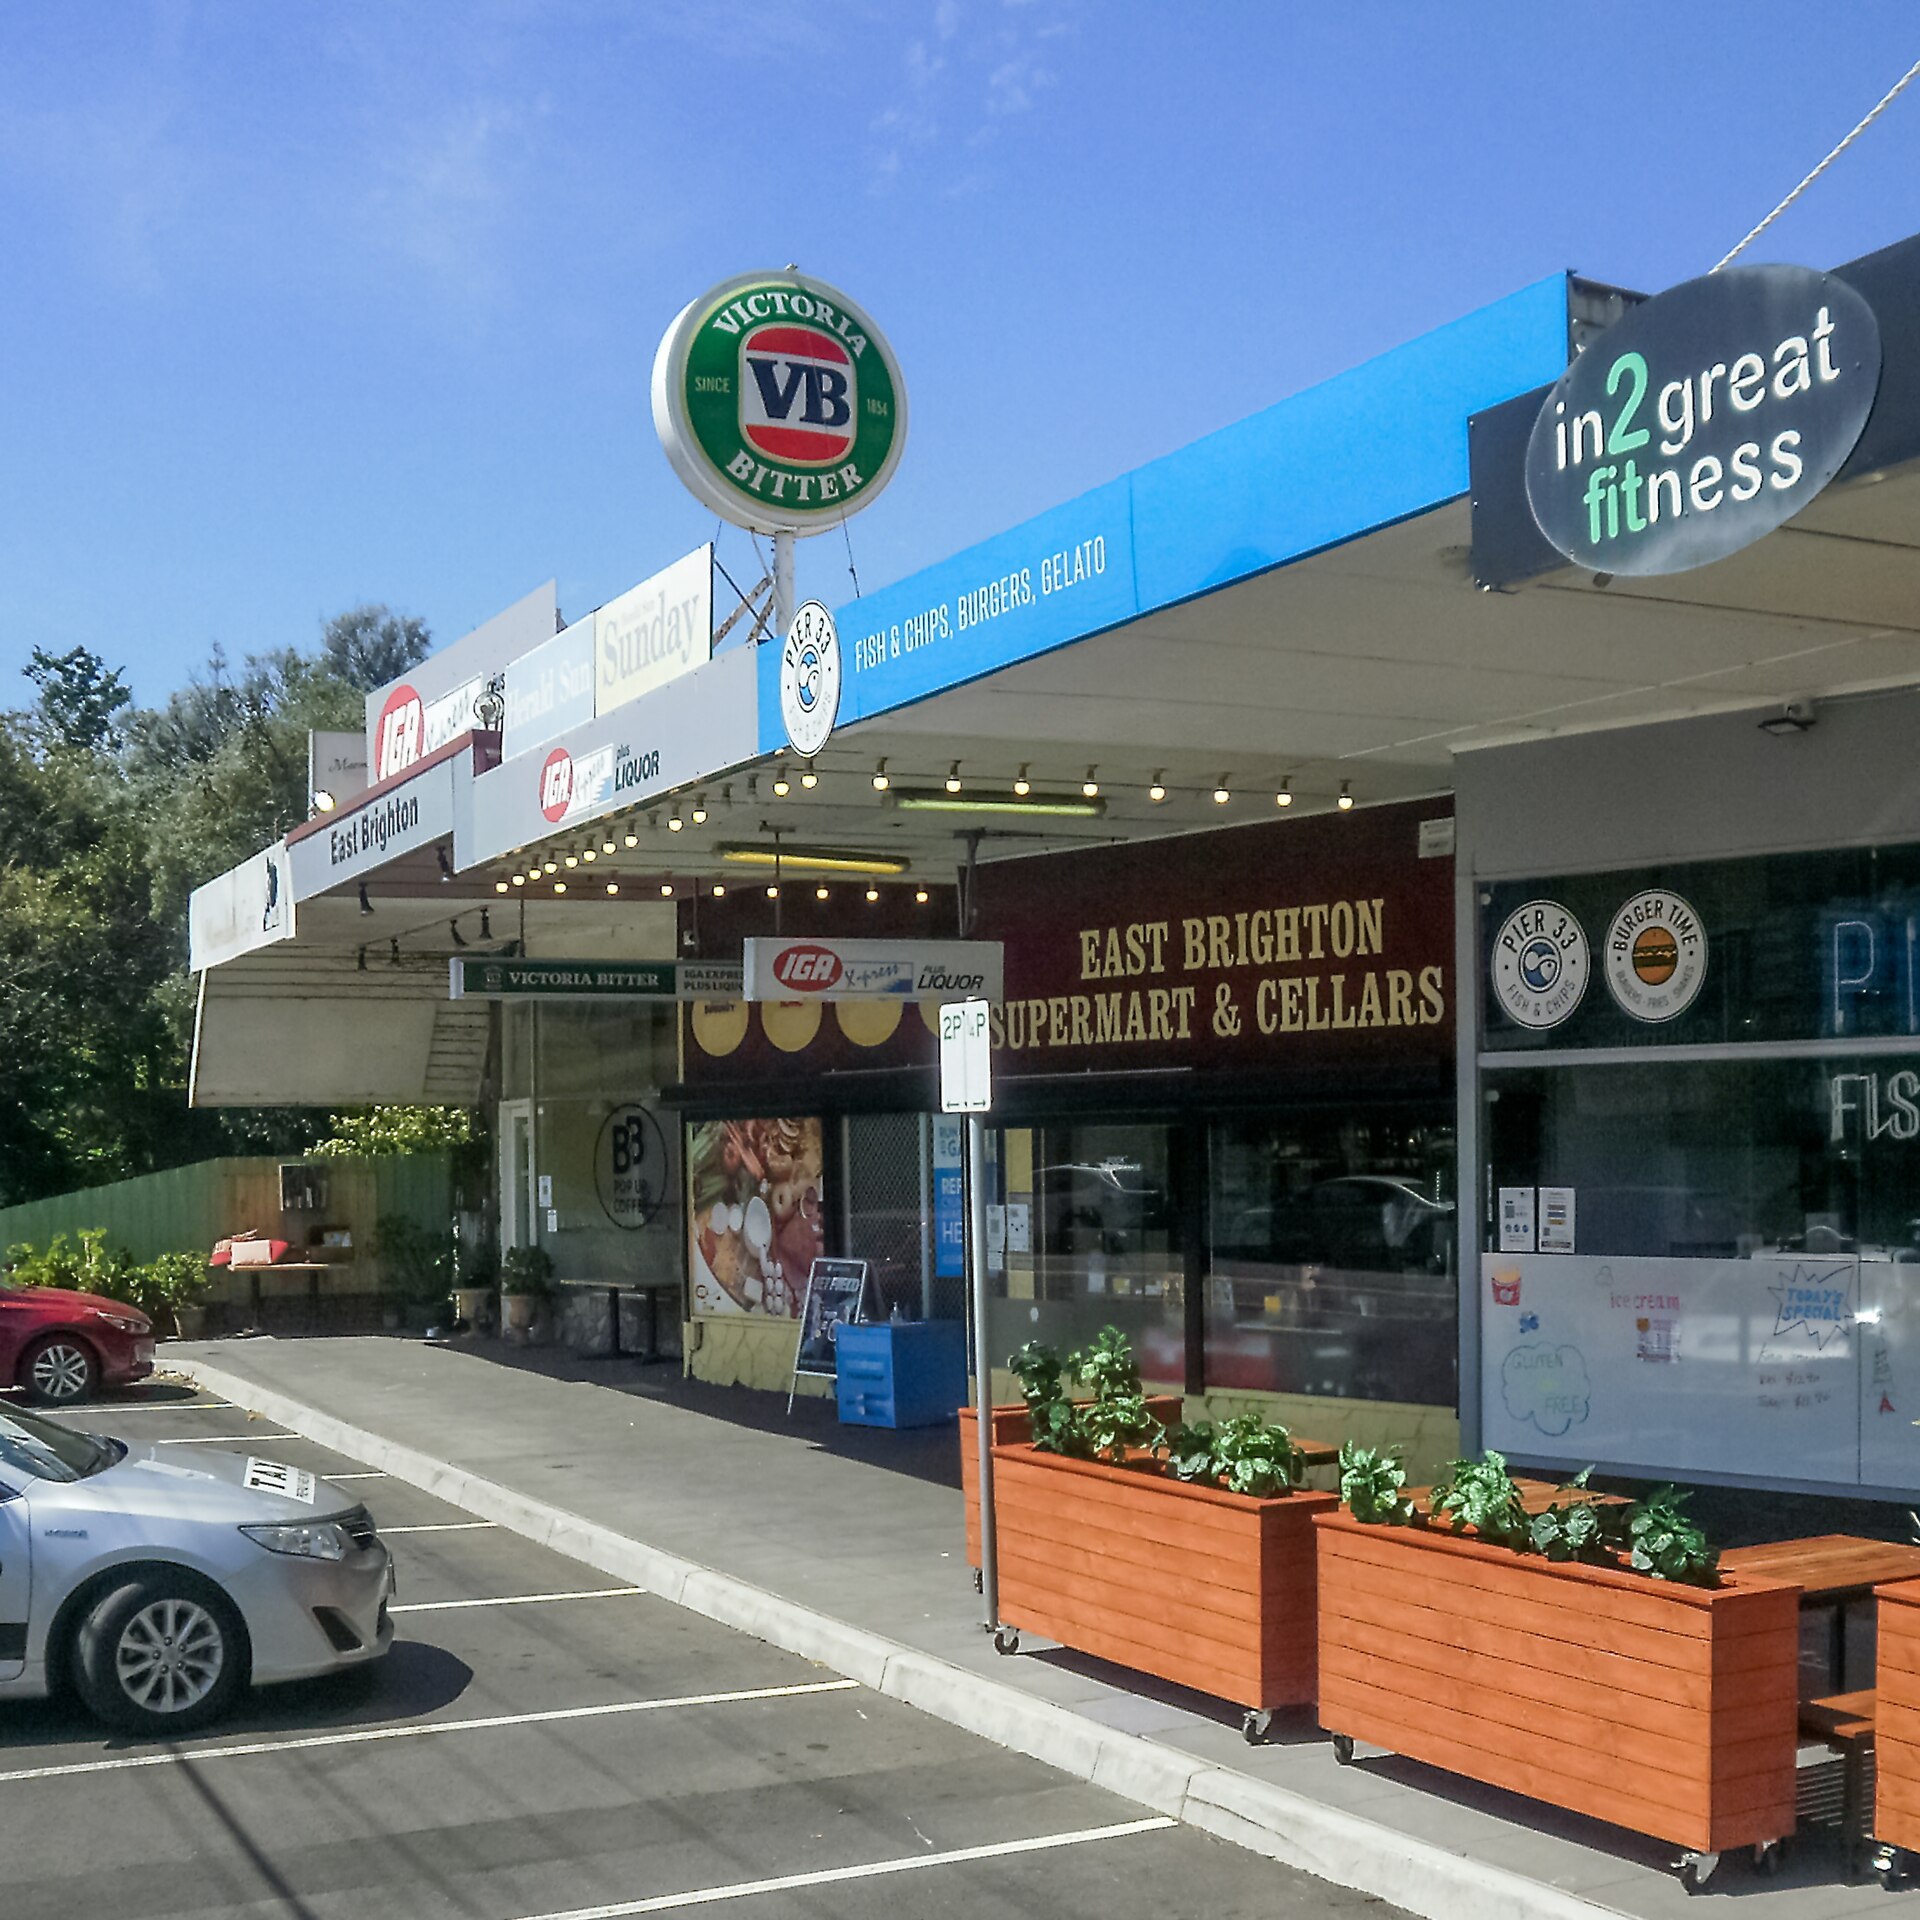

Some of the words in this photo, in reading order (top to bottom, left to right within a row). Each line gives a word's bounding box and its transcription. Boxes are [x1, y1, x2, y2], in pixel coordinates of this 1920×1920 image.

[712, 291, 868, 359] VICTORIA
[694, 376, 731, 394] SINCE
[746, 357, 851, 427] VB
[725, 449, 864, 501] BITTER
[1583, 430, 1803, 545] fitness
[854, 631, 887, 673] FISH
[890, 624, 901, 659] &
[904, 602, 954, 653] CHIPS,
[957, 567, 1037, 632] BURGERS,
[1041, 535, 1106, 596] GELATO
[602, 589, 700, 687] Sunday
[785, 611, 812, 669] PIER
[815, 617, 832, 655] 33
[558, 660, 592, 704] Sun
[378, 697, 421, 782] IGA
[542, 757, 571, 811] IGA
[615, 750, 660, 792] LIQUOR
[330, 821, 358, 866] East
[361, 796, 419, 852] Brighton
[1079, 921, 1169, 980] EAST
[1182, 898, 1385, 971] BRIGHTON
[1502, 909, 1545, 953] PIER
[1552, 917, 1578, 950] 33
[1613, 899, 1664, 951] BURGER
[1668, 904, 1698, 946] TIME
[508, 971, 592, 986] VICTORIA
[596, 972, 660, 986] BITTER
[684, 969, 704, 979] IGA
[684, 980, 711, 991] PLUS
[780, 953, 836, 981] IGA
[917, 974, 984, 990] LIQUOR
[1505, 984, 1529, 1013] FISH
[1533, 1007, 1541, 1017] &
[1546, 978, 1576, 1016] CHIPS
[943, 1014, 962, 1040] 2P
[990, 986, 1196, 1051] SUPERMART
[1212, 982, 1241, 1037] &
[1256, 965, 1445, 1035] CELLARS
[1781, 1305, 1841, 1322] SPECIAL
[1511, 1352, 1563, 1370] GLUTEN
